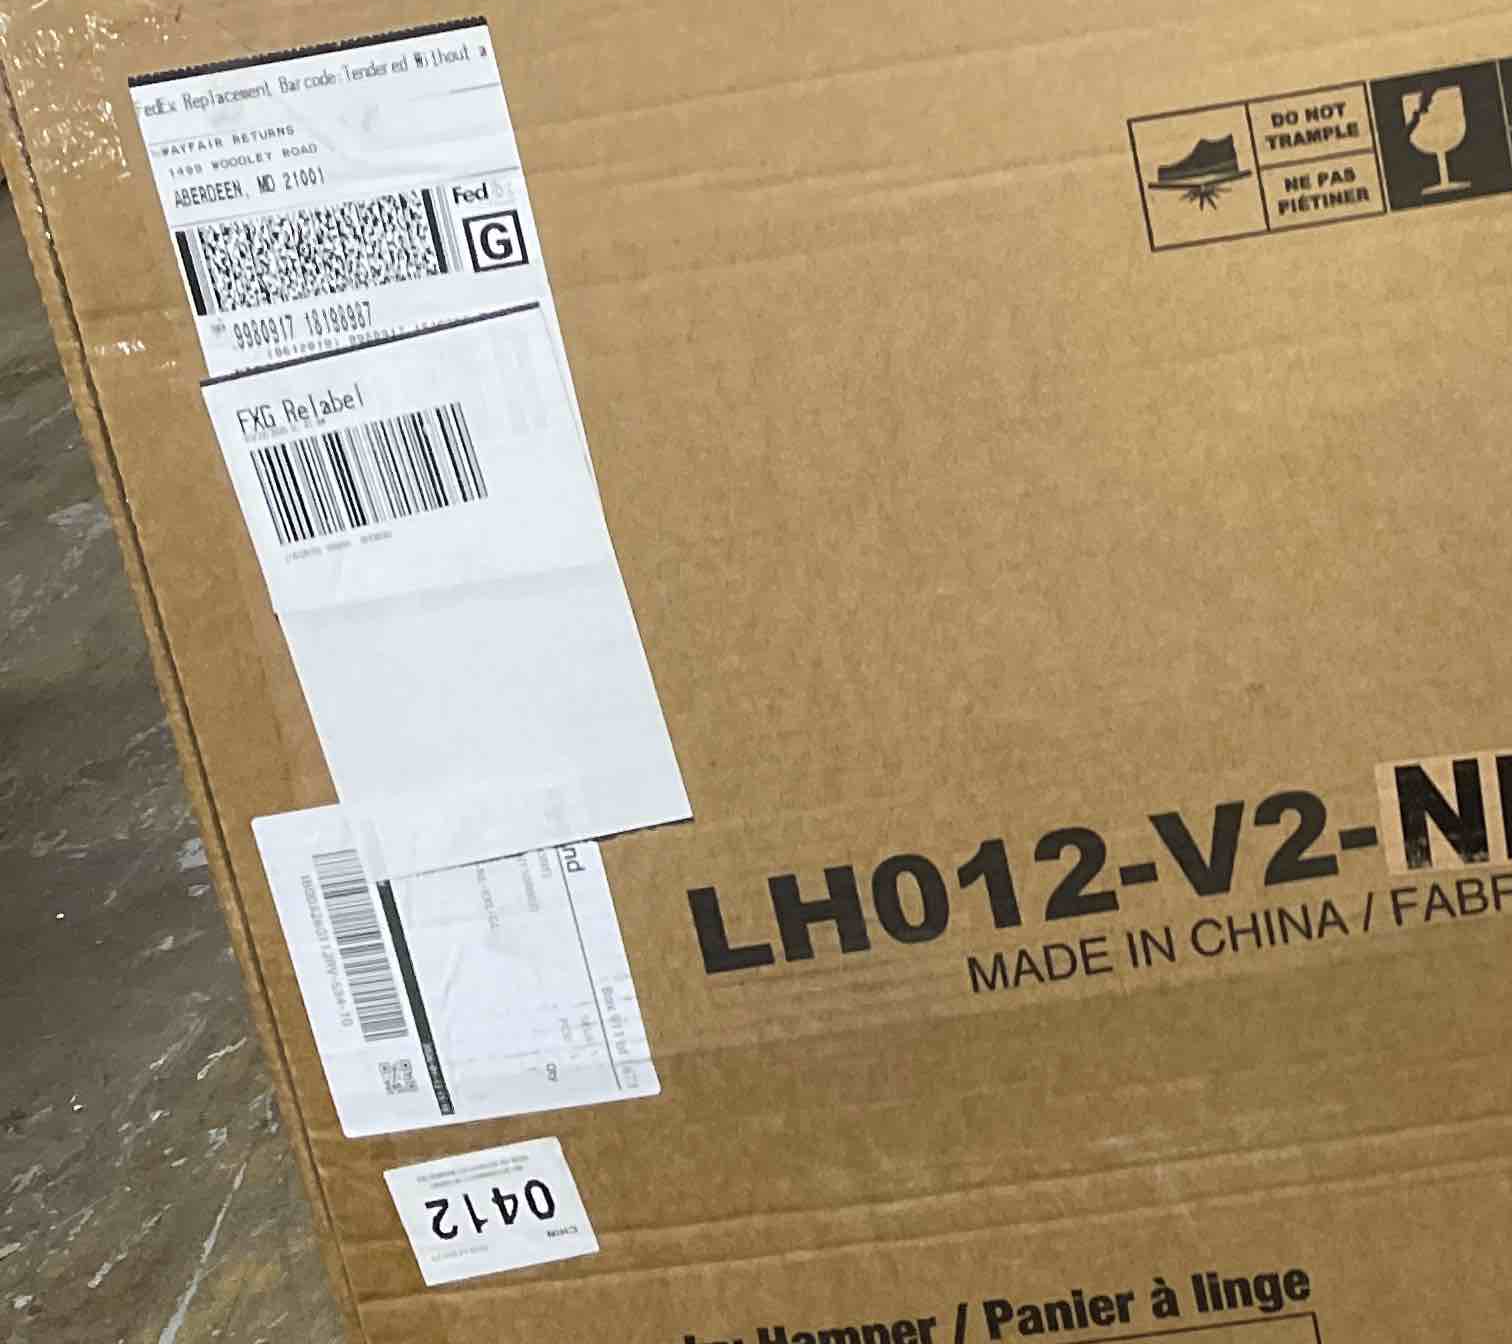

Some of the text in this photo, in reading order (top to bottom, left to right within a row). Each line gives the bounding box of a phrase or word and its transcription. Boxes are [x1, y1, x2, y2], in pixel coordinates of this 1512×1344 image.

[136, 44, 489, 119] edEx Replacement Barcode Tendered Without a
[1270, 101, 1347, 129] DO NOT
[161, 123, 296, 158] WAYFAIR RETURNS
[281, 141, 319, 161] ROAD
[1265, 121, 1361, 152] TRAMPLE
[173, 166, 327, 210] ABERDEEN, MD 21001
[1283, 167, 1357, 193] NE PAS
[1276, 185, 1371, 217] PIÉTINER
[479, 222, 513, 260] G
[231, 312, 297, 352] 9980917
[236, 404, 277, 434] FXG
[281, 383, 366, 422] Relabel
[966, 935, 1113, 994] MADE
[1126, 923, 1177, 971] IN
[1191, 897, 1351, 956] CHINA
[1360, 890, 1377, 934] /
[424, 1178, 557, 1241] 0412
[985, 1288, 1138, 1344] Panier
[1150, 1276, 1180, 1320] à
[1193, 1265, 1313, 1321] linge
